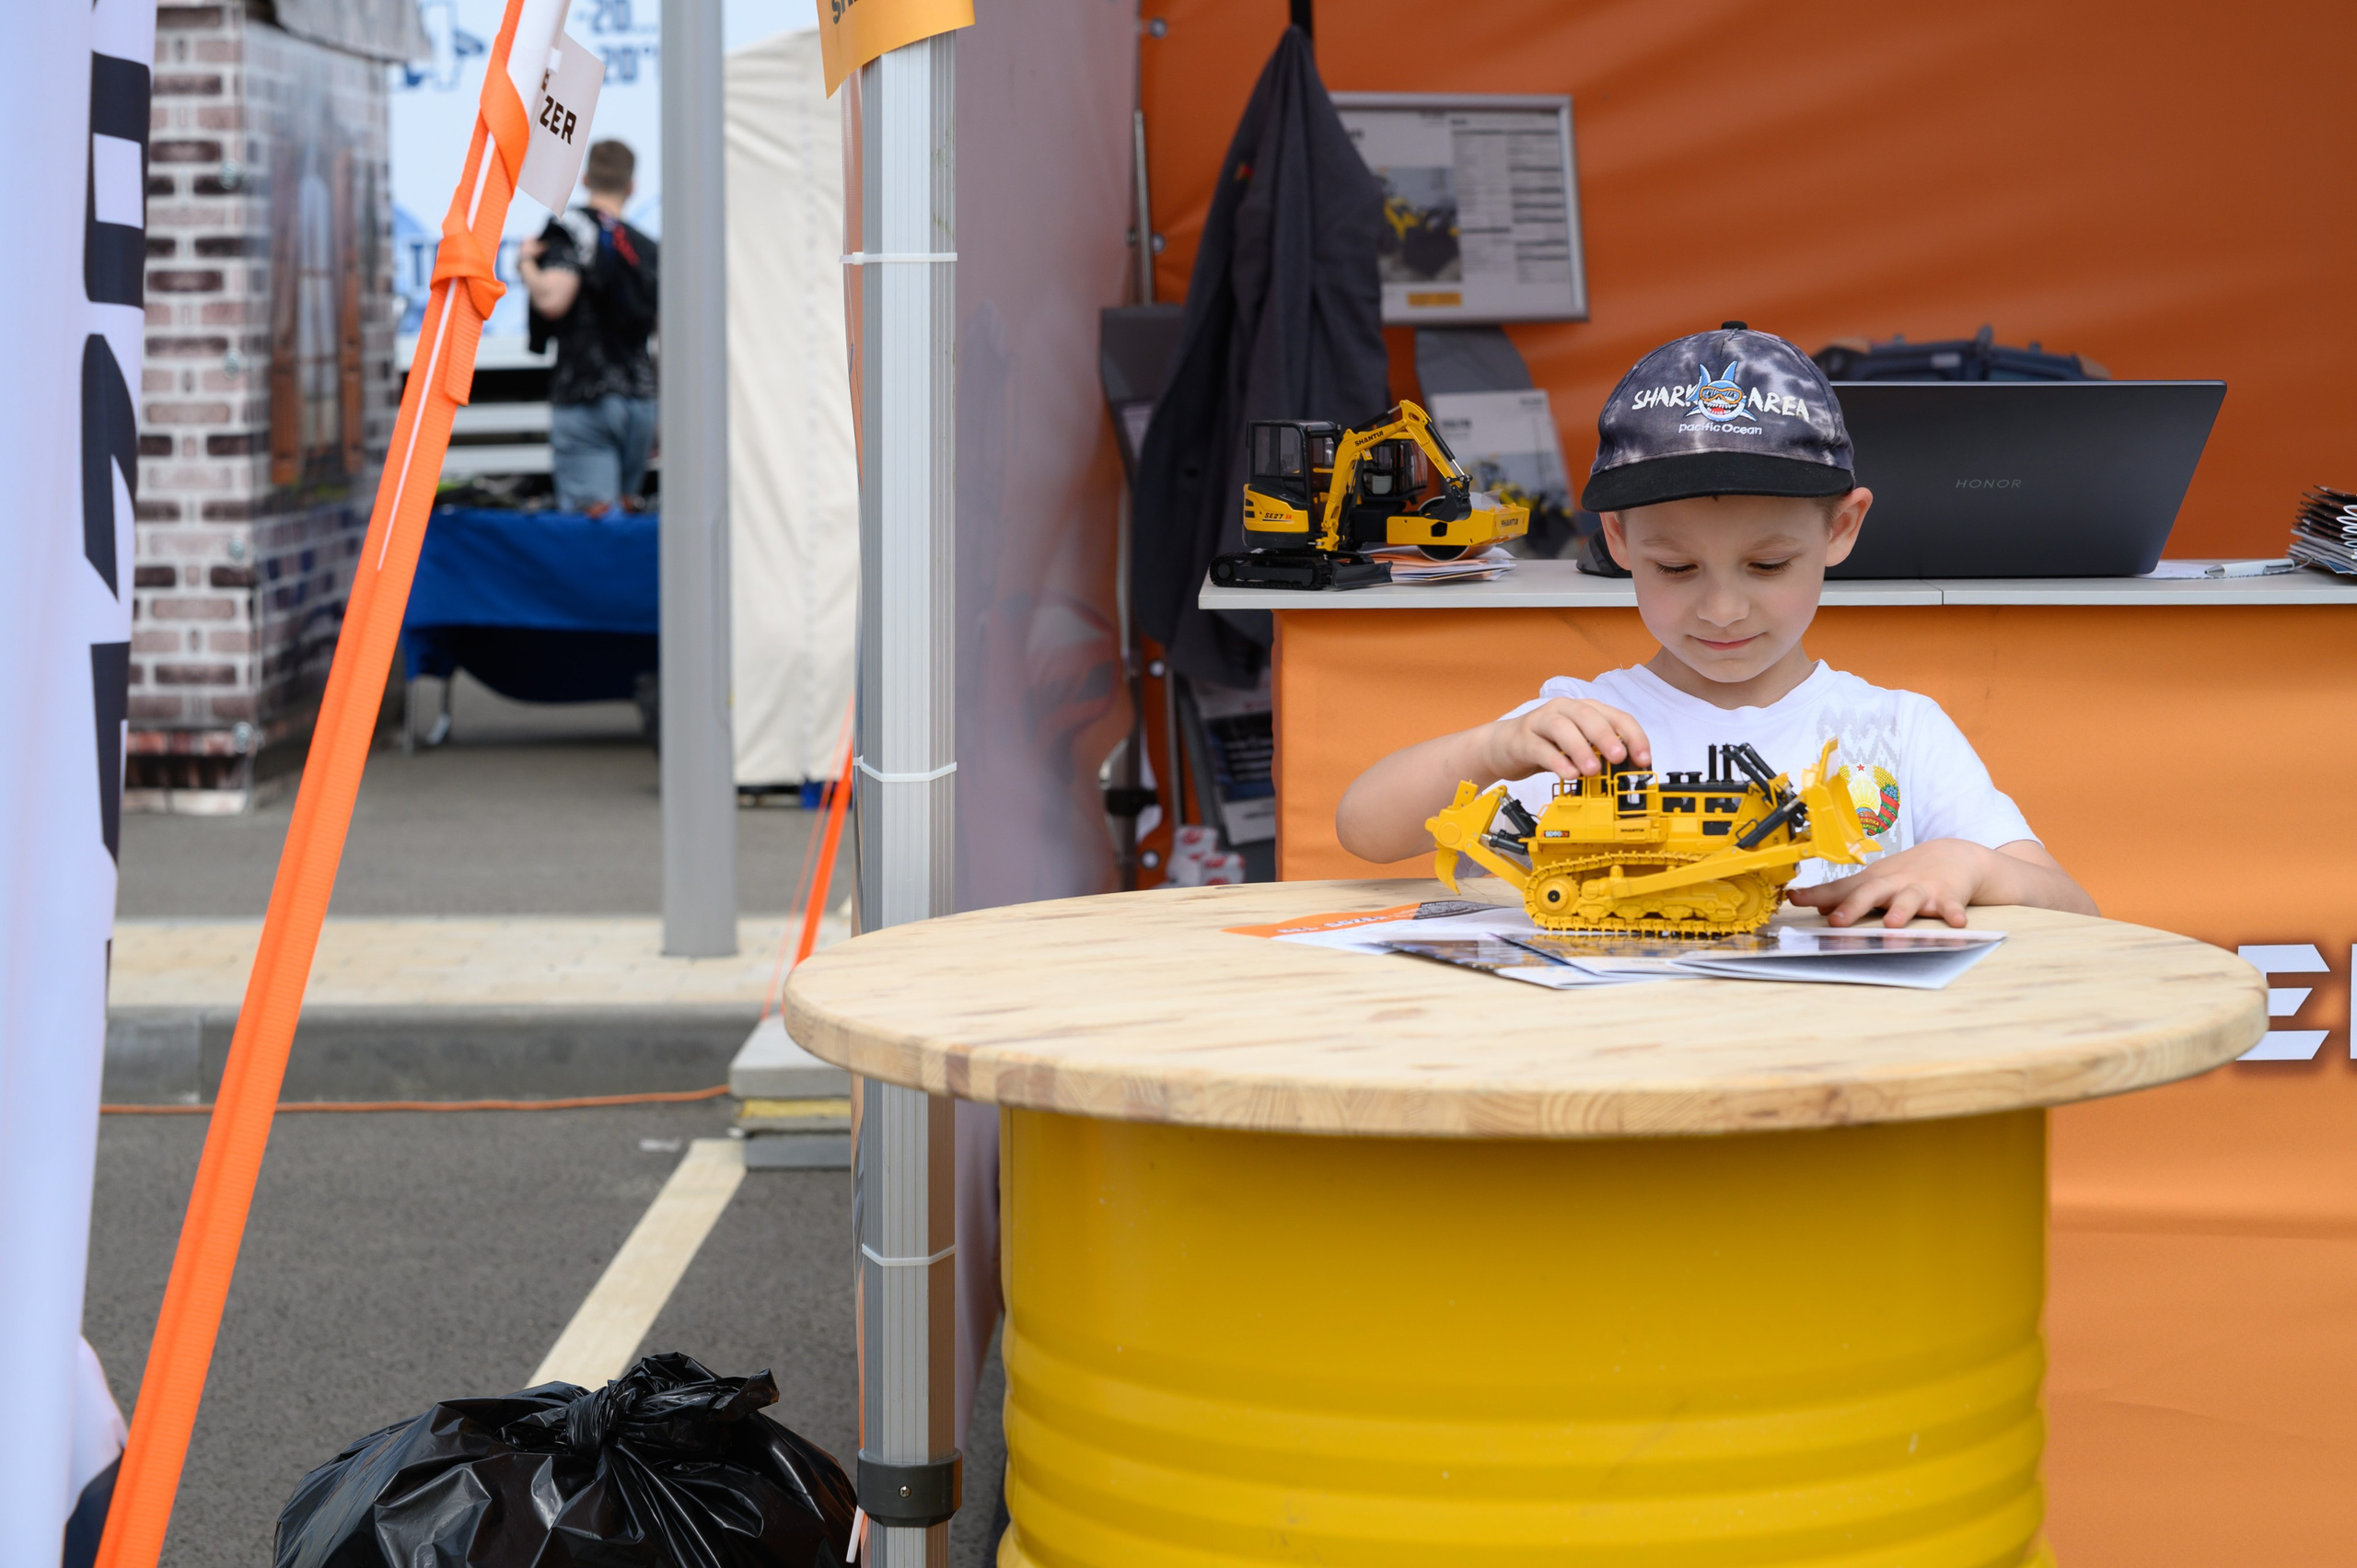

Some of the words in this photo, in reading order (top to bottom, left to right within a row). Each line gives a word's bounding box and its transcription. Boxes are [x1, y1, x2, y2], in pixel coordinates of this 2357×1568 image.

[1747, 387, 1810, 424] AREA
[1354, 430, 1384, 447] SHANTUI
[1722, 424, 1762, 436] Ocean
[1956, 479, 2022, 489] HONOR
[2235, 943, 2357, 1061] E
